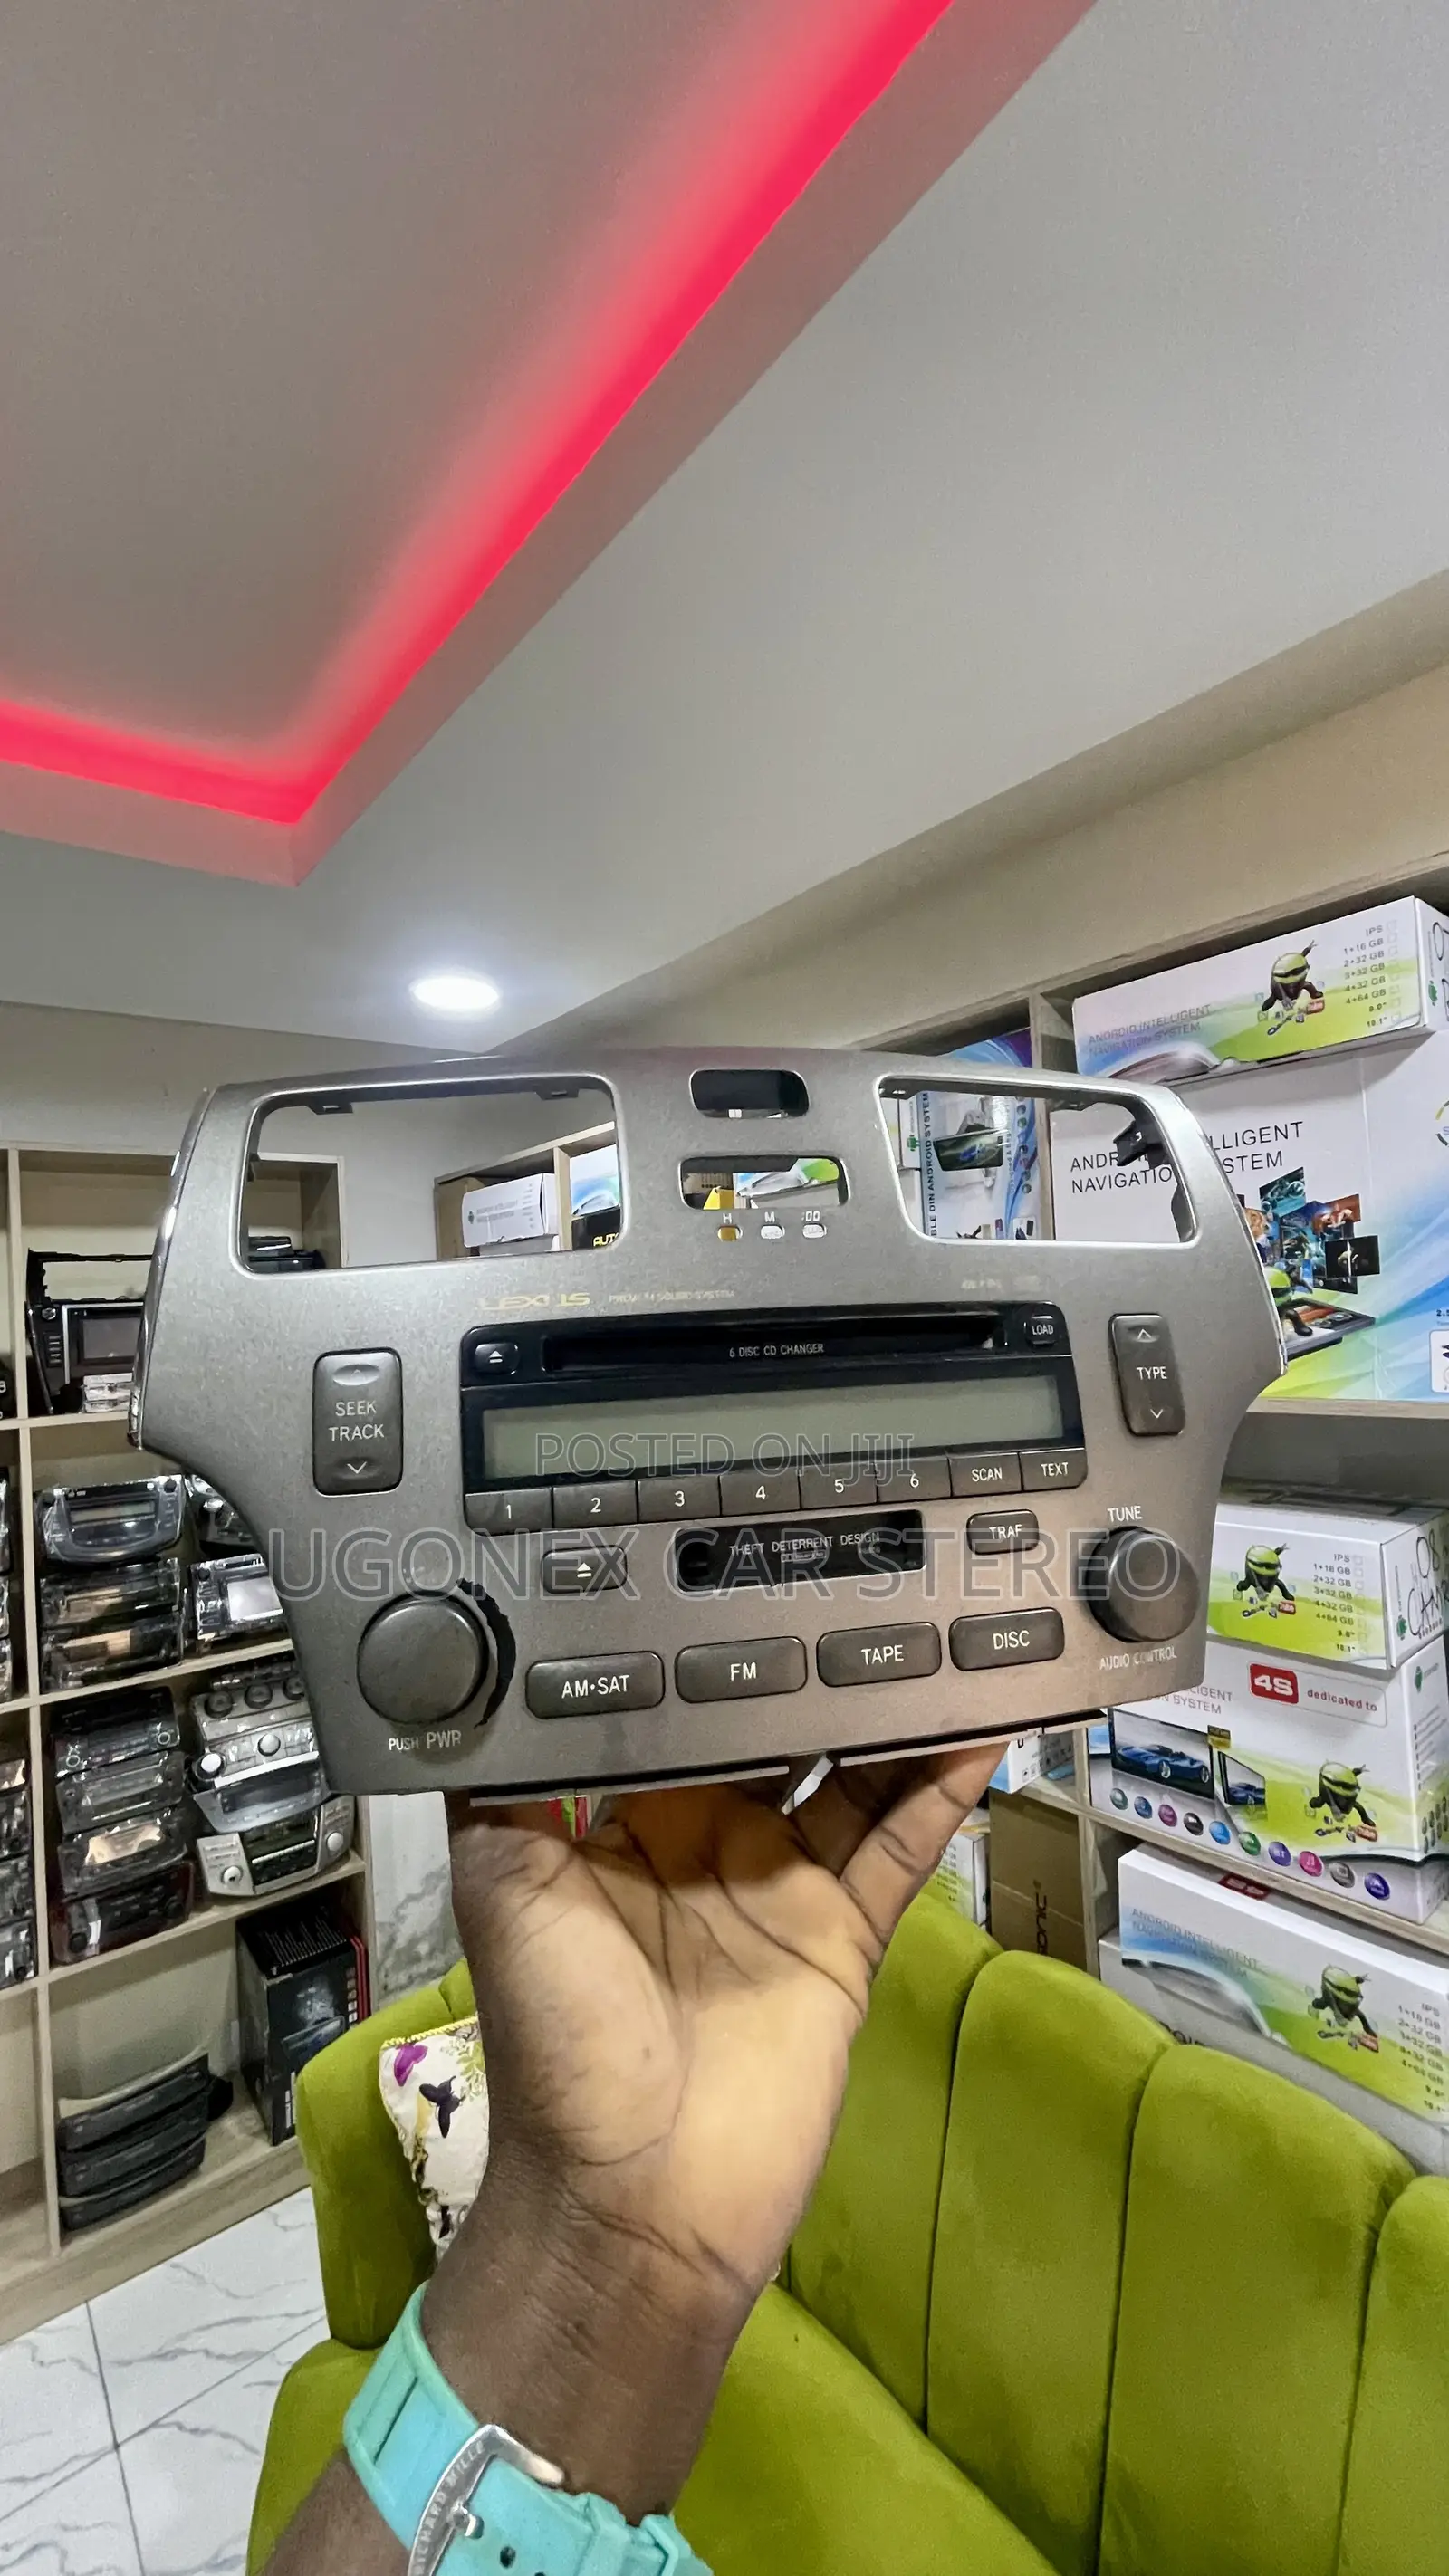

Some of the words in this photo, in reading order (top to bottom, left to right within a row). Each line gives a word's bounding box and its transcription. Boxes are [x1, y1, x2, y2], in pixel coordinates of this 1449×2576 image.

[1366, 924, 1384, 937] IPS
[1368, 937, 1384, 949] GB
[1369, 950, 1385, 961] GB
[1370, 962, 1386, 973] GB
[1371, 975, 1386, 986] GB
[1371, 988, 1387, 999] GB
[1139, 1004, 1212, 1032] INTELLIGENT
[925, 1141, 936, 1192] ANDROID
[1072, 1166, 1173, 1194] NAVIGATIO
[1222, 1150, 1284, 1175] STEM
[722, 1212, 733, 1224] H
[763, 1211, 776, 1223] M
[1032, 1324, 1054, 1336] LOAD
[729, 1347, 735, 1358] 6
[738, 1345, 760, 1357] DISC
[763, 1345, 777, 1355] CD
[780, 1343, 824, 1355] CHANGER
[1137, 1365, 1167, 1381] TYPE
[335, 1399, 378, 1416] SEEK
[329, 1423, 385, 1442] TRACK
[971, 1466, 1003, 1483] SCAN
[1041, 1461, 1070, 1478] TEXT
[834, 1479, 845, 1494] 5
[909, 1473, 920, 1489] 6
[674, 1490, 686, 1508] 3
[754, 1485, 767, 1500] 4
[505, 1504, 513, 1520] 1
[590, 1497, 602, 1514] 2
[1107, 1505, 1143, 1523] TUNE
[988, 1524, 1022, 1540] TRAF
[729, 1542, 765, 1556] THEFT
[772, 1535, 834, 1552] DETERRENT
[840, 1531, 880, 1545] DESIGN
[1333, 1553, 1351, 1563] IPS
[1337, 1565, 1351, 1575] GB
[1313, 1575, 1336, 1585] 2+32
[1338, 1577, 1352, 1588] GB
[1338, 1589, 1353, 1601] GB
[1339, 1604, 1354, 1614] GB
[1339, 1616, 1354, 1626] GB
[993, 1630, 1031, 1651] DISC
[860, 1644, 905, 1666] TAPE
[1099, 1653, 1130, 1671] AUDIO
[1132, 1644, 1177, 1666] CNTROL
[729, 1661, 757, 1682] FM
[1253, 1674, 1295, 1698] 4S
[1307, 1689, 1363, 1709] dedicated
[1366, 1701, 1377, 1712] to
[1169, 1694, 1222, 1715] SYSTEM
[388, 1736, 419, 1751] PUSH
[427, 1729, 462, 1750] PWR
